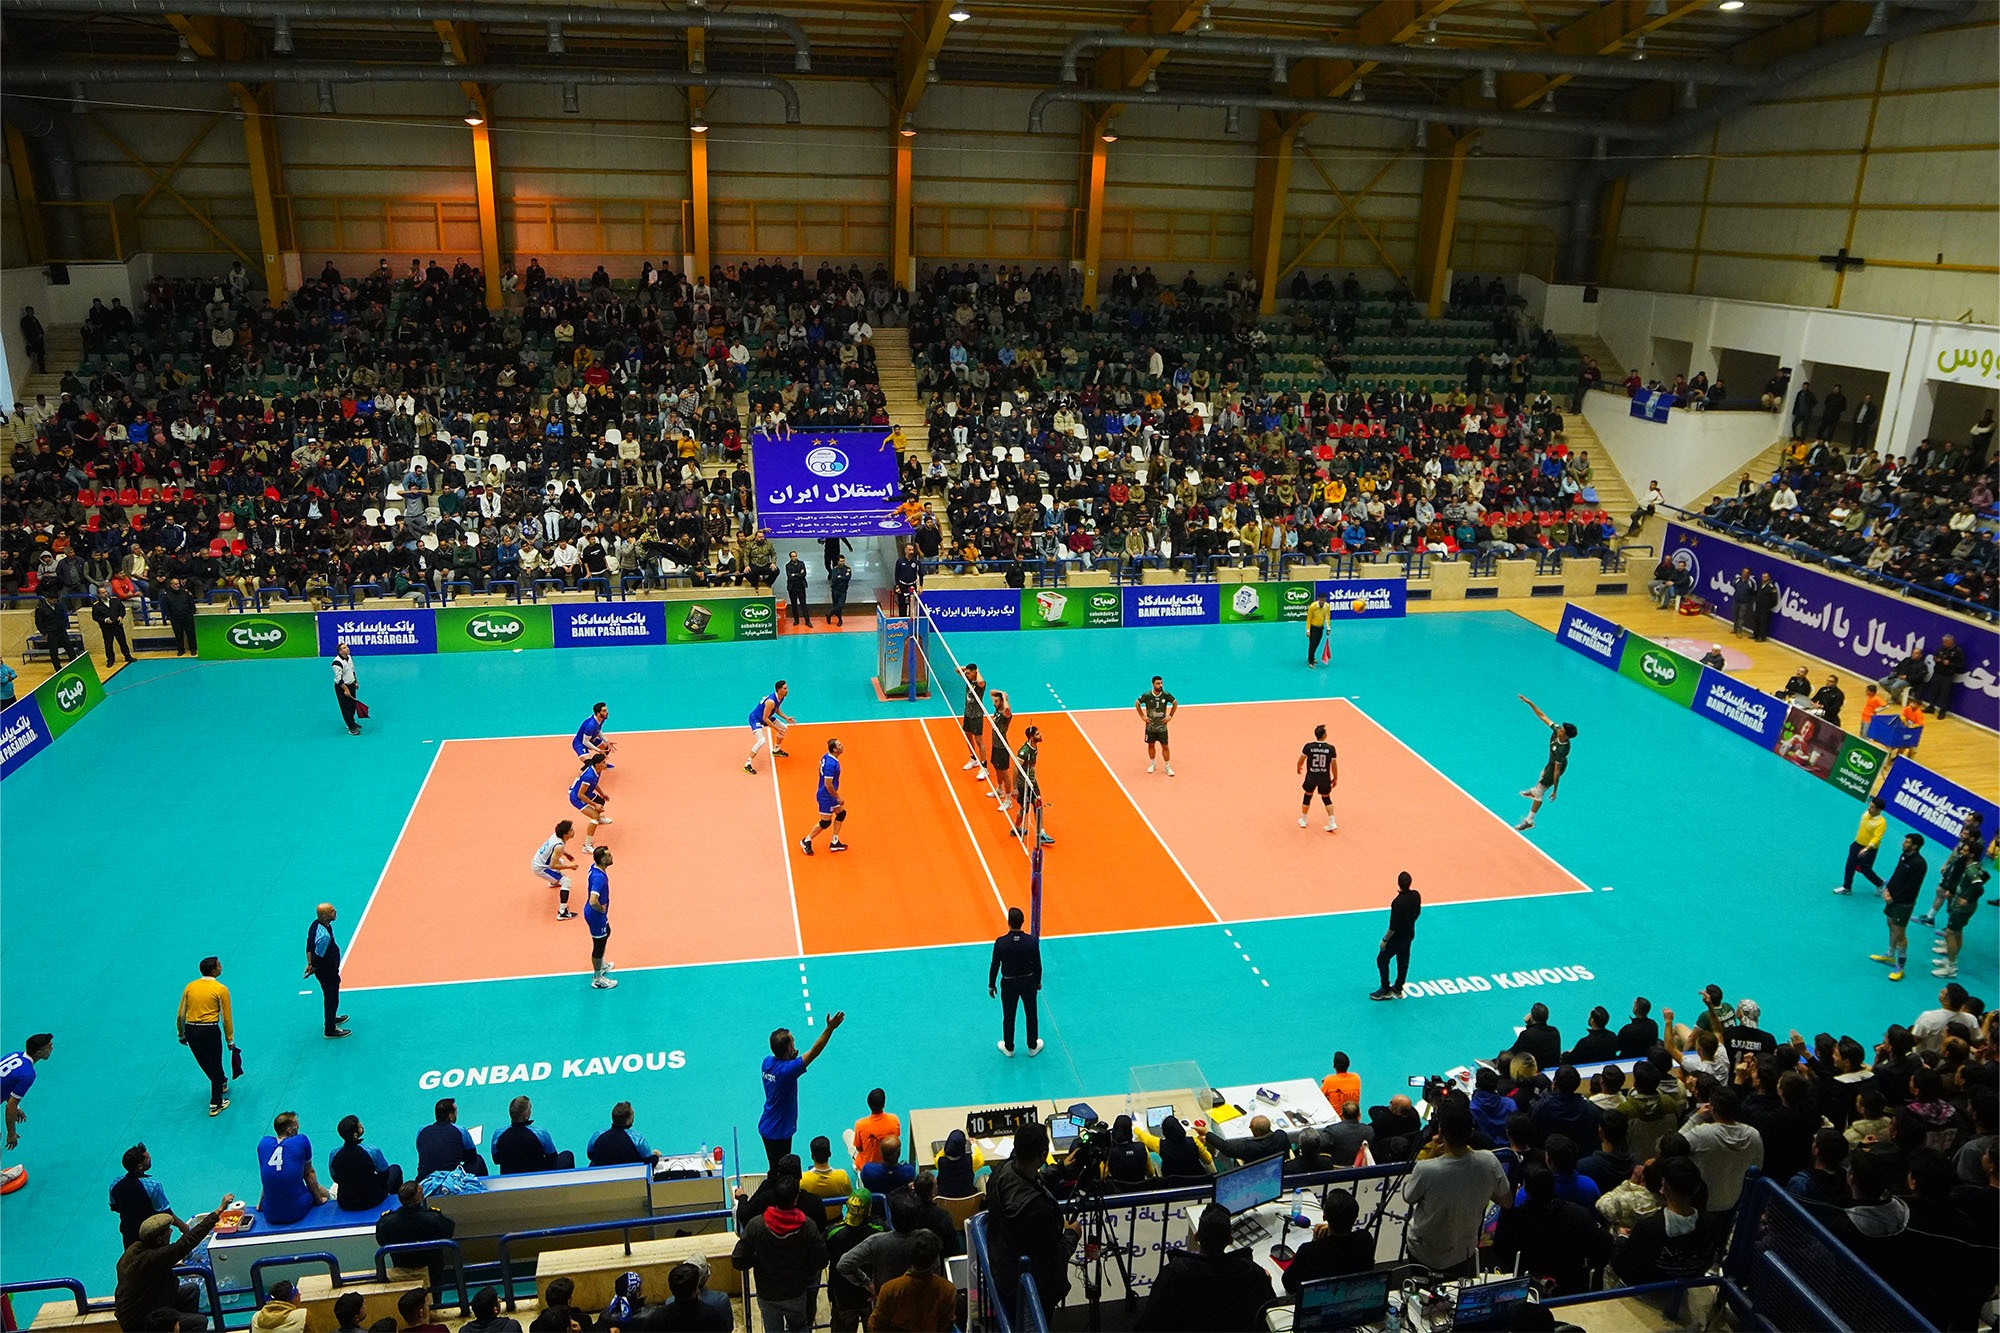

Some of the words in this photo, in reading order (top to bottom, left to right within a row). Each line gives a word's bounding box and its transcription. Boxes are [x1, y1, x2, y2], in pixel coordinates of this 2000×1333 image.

[769, 484, 819, 504] ایران
[825, 482, 893, 503] استقلال
[942, 606, 960, 618] ایران
[961, 606, 987, 617] والیبال
[986, 606, 1000, 617] برتر
[1000, 605, 1015, 616] لیگ
[1093, 597, 1116, 607] صباح
[1138, 607, 1160, 618] BANK
[1161, 606, 1203, 617] PASARGAD
[1330, 601, 1350, 611] BANK
[1770, 582, 1833, 632] استقلا
[743, 608, 769, 618] صباح
[234, 626, 282, 645] صباح
[472, 619, 520, 637] صباح
[572, 627, 597, 638] BANK
[598, 626, 646, 636] PASARGAD
[1832, 606, 1851, 648] با
[338, 634, 364, 645] BANK
[365, 634, 415, 645] PASARGAD
[1567, 627, 1584, 645] BANK
[1581, 632, 1612, 658] PASARGAD
[1643, 654, 1675, 680] صباح
[57, 680, 84, 709] صباح
[1706, 695, 1728, 717] BANK
[1724, 702, 1765, 734] PASARGAD
[2, 728, 37, 761] PASARGAD
[1894, 790, 1922, 814] BANK
[1917, 803, 1963, 839] PASARGA
[1491, 965, 1595, 989] KAVOUS
[0, 1053, 23, 1077] 18
[418, 1061, 552, 1090] GONBAD
[561, 1050, 687, 1079] KAVOUS
[971, 1117, 985, 1133] 10
[987, 1119, 993, 1130] 1
[1015, 1116, 1020, 1127] 1
[1023, 1111, 1036, 1124] 11
[268, 1146, 284, 1171] 4
